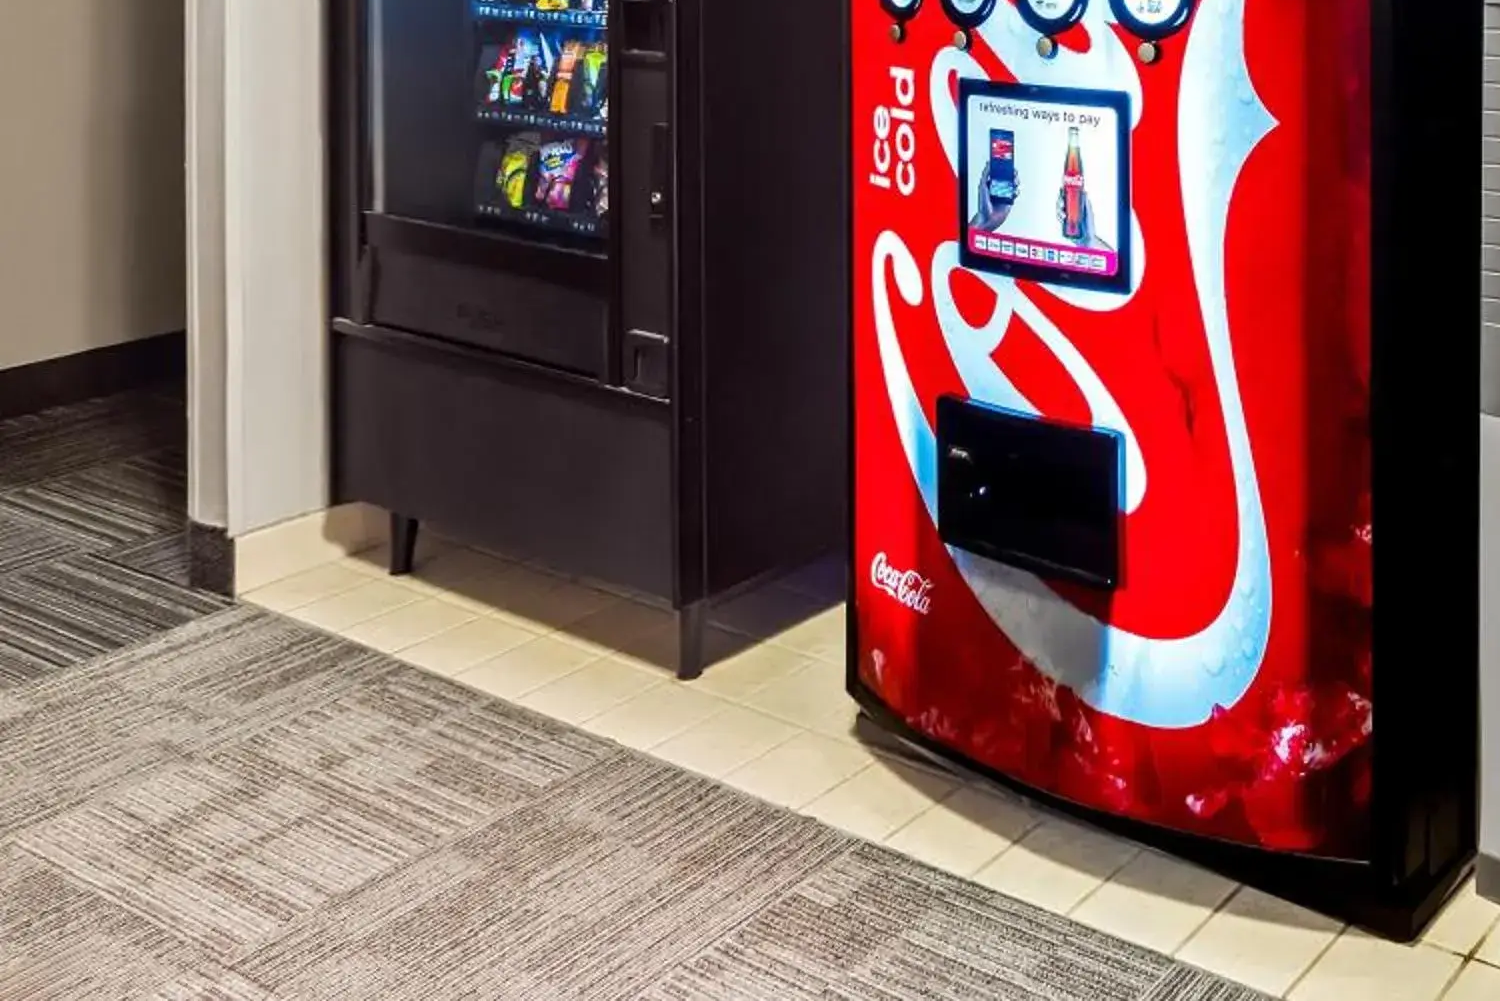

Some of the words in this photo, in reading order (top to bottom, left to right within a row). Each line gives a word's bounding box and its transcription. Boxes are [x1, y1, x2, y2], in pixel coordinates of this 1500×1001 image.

[869, 104, 891, 189] ice
[889, 65, 916, 197] cold
[979, 101, 1029, 120] refreshing
[1031, 109, 1061, 123] ways
[1063, 111, 1076, 124] to
[1078, 113, 1101, 128] pay
